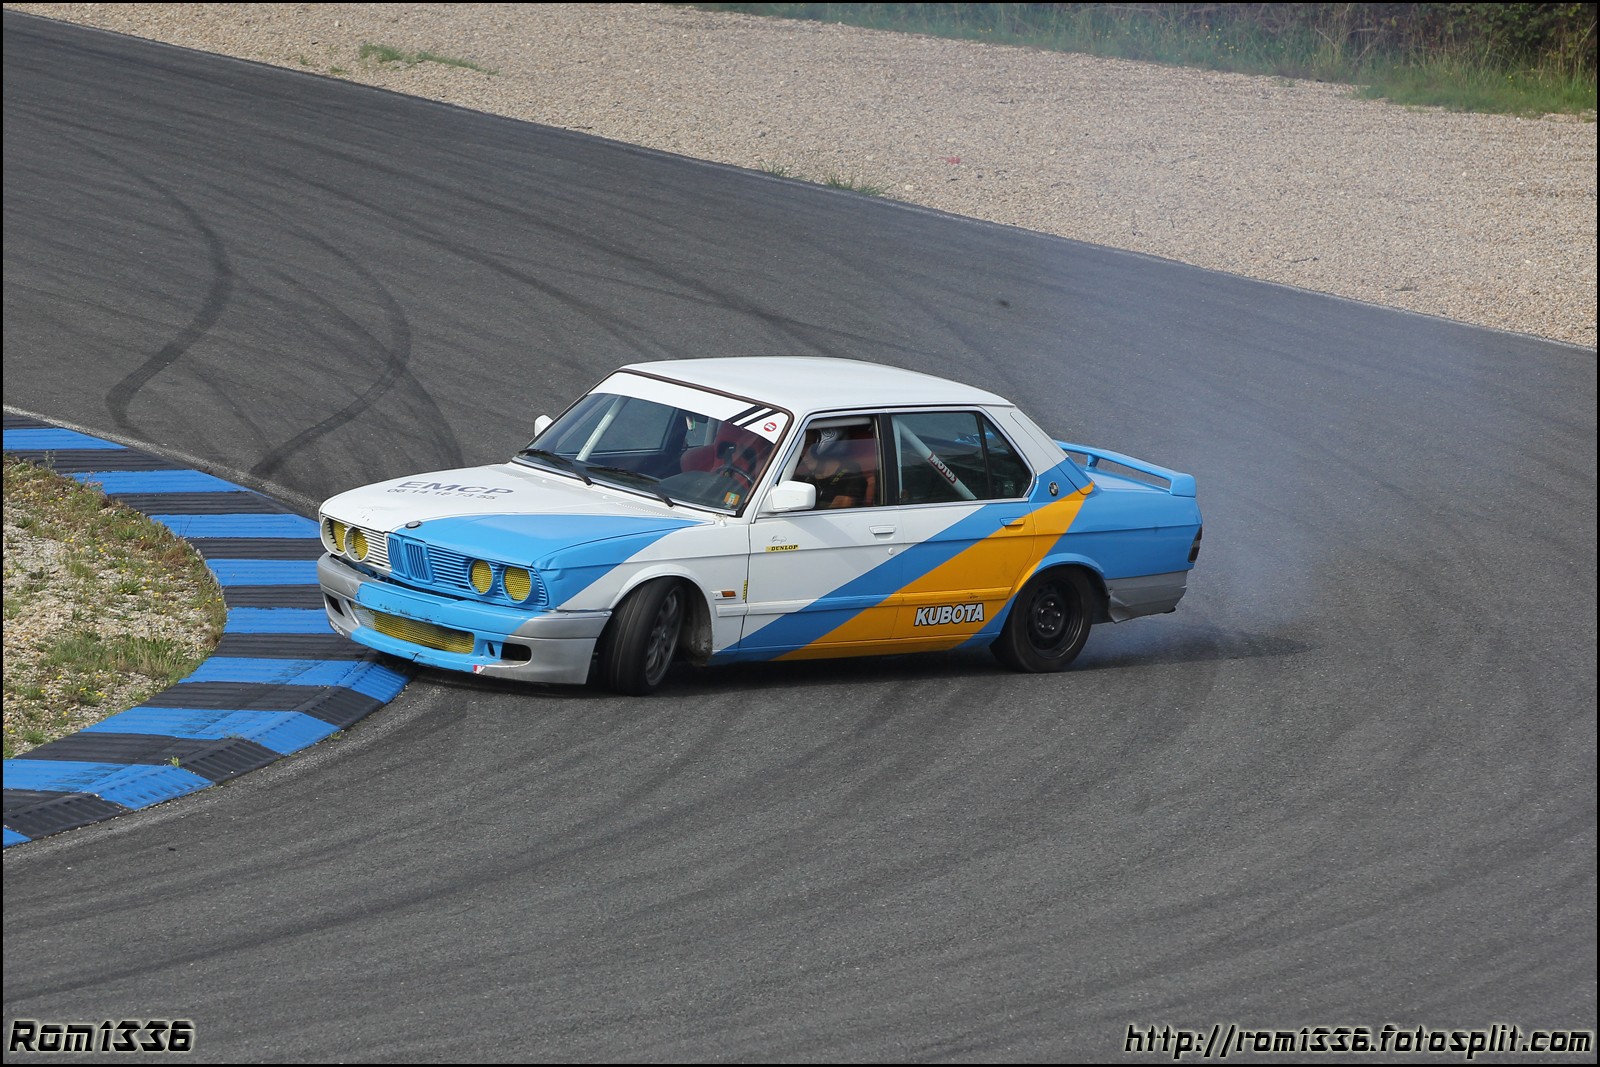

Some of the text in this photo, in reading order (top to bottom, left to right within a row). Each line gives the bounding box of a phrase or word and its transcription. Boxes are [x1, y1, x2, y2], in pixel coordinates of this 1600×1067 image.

[929, 453, 956, 482] MOTUL
[398, 481, 514, 494] EMCP
[914, 603, 984, 626] KUBOTA
